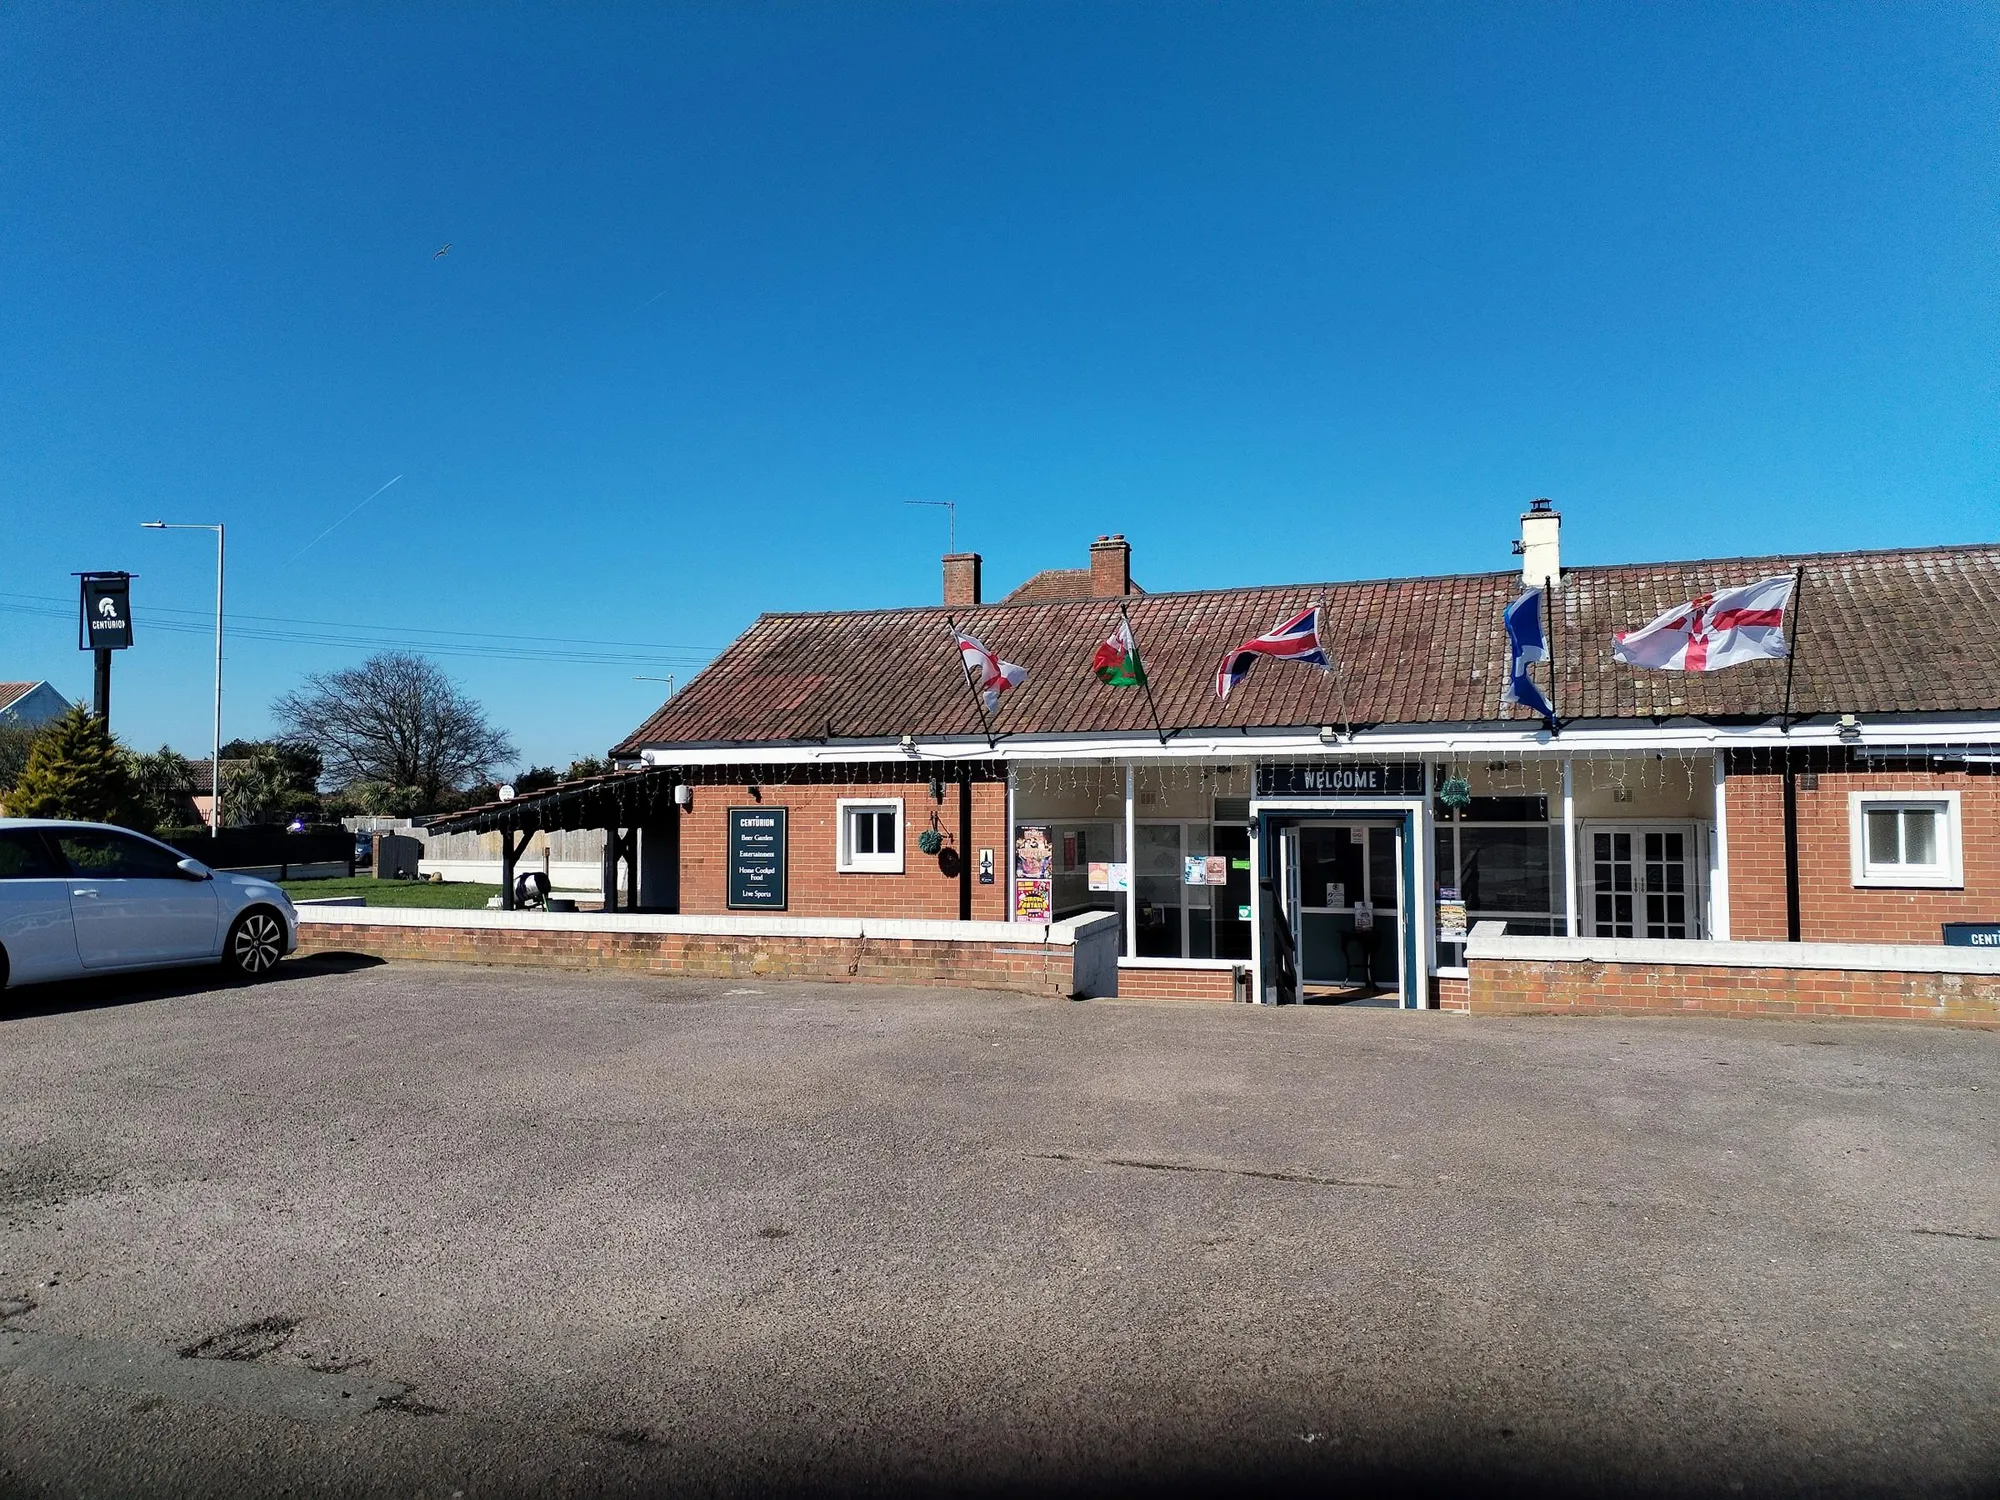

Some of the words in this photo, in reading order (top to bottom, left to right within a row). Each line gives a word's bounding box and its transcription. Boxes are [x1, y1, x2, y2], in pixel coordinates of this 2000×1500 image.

[1304, 771, 1377, 789] WELCOME
[740, 818, 775, 827] CENTURION
[739, 850, 775, 858] Entertainment
[738, 866, 755, 874] Home
[755, 866, 776, 875] Cooked
[750, 873, 764, 881] Food
[742, 889, 754, 897] Live
[754, 889, 772, 899] Sports
